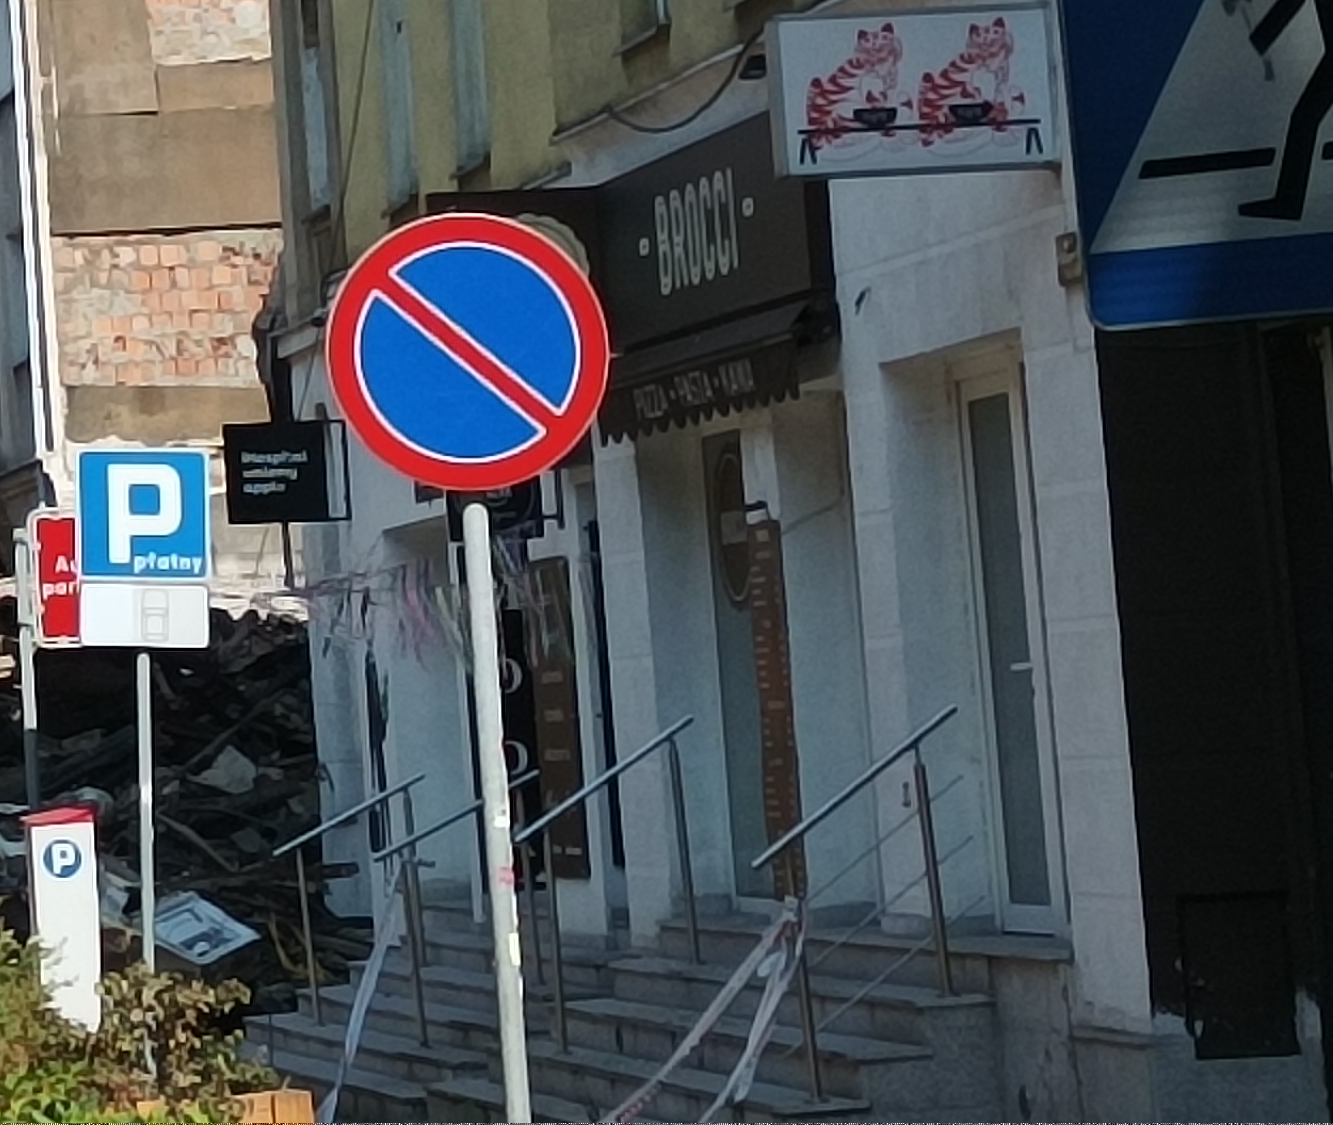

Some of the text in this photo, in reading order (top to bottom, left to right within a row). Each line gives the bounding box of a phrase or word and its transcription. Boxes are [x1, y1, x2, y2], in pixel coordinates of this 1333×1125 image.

[654, 167, 739, 296] BROCCI
[107, 463, 182, 564] P
[42, 581, 79, 600] par
[51, 843, 76, 874] P
